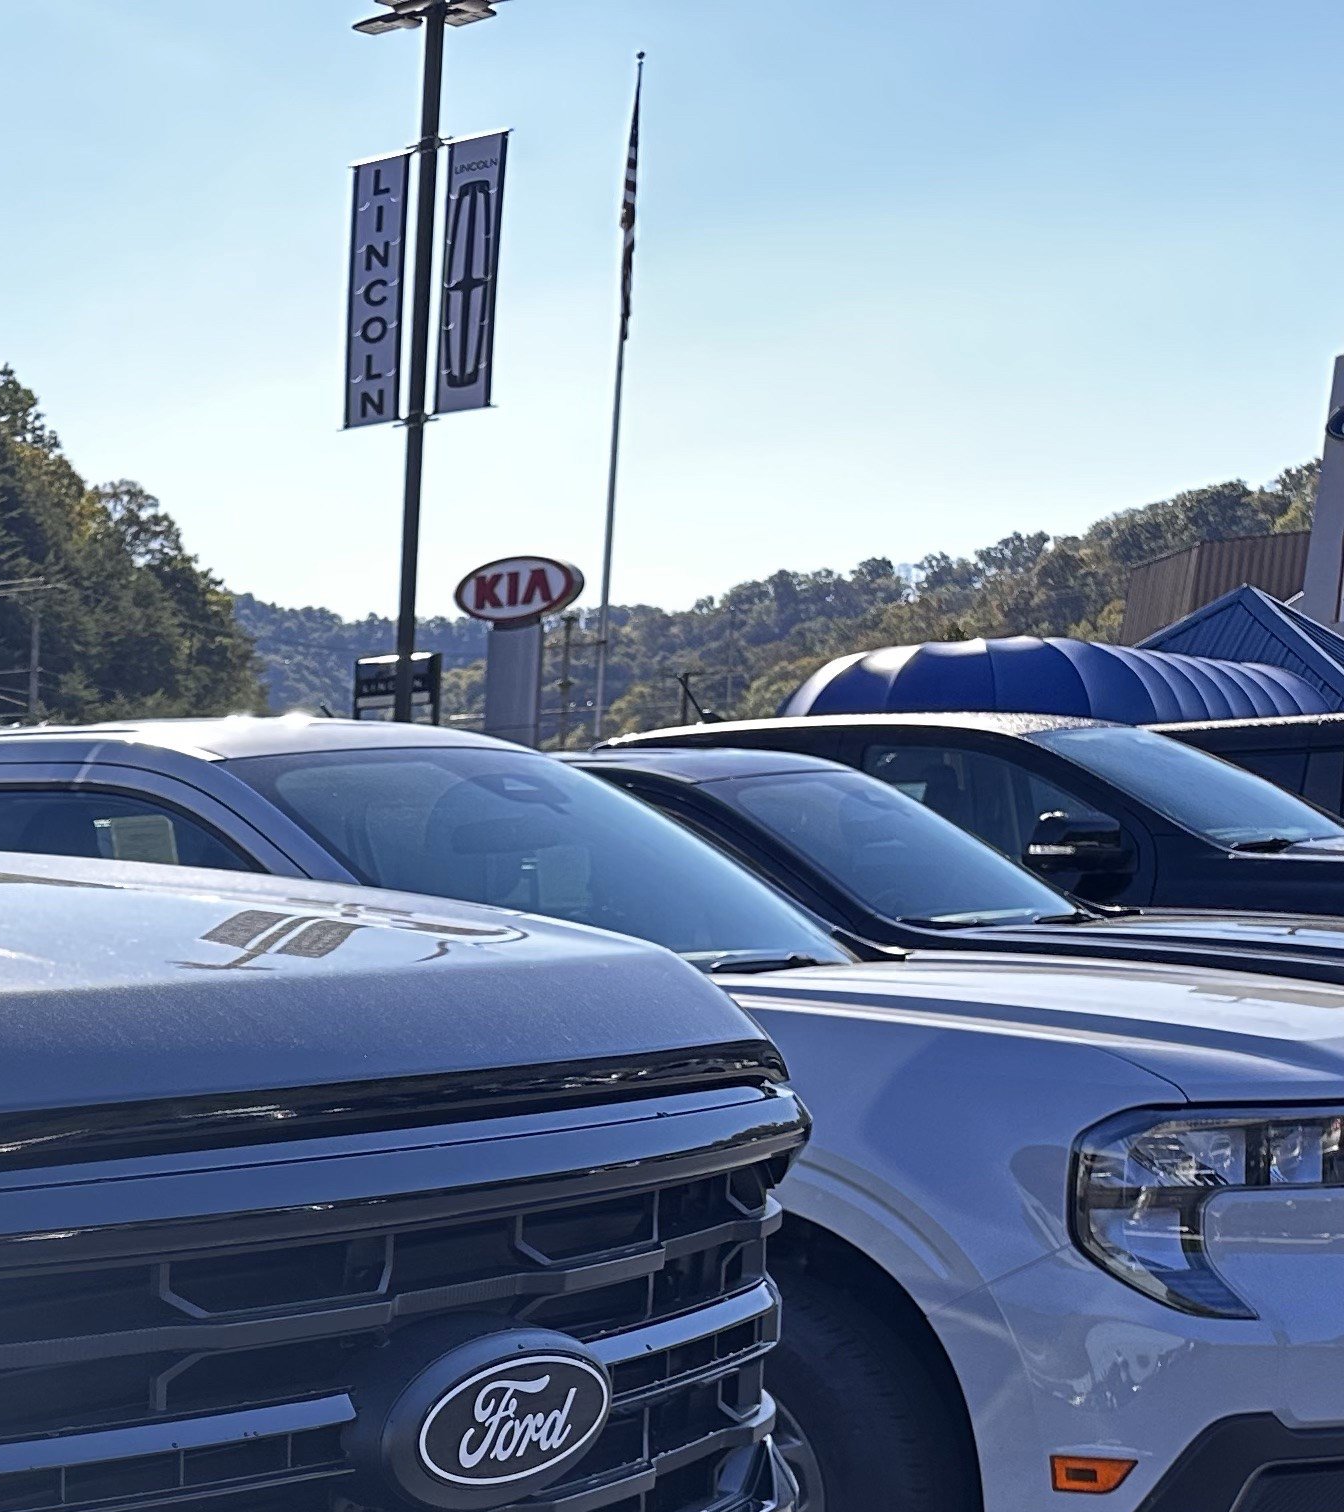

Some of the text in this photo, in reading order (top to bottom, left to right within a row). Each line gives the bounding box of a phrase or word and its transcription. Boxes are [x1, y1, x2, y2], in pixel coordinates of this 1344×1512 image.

[454, 157, 499, 175] LINCOLN
[361, 168, 390, 419] LINCOLN
[473, 568, 553, 610] KIA
[458, 1374, 578, 1470] Ford
